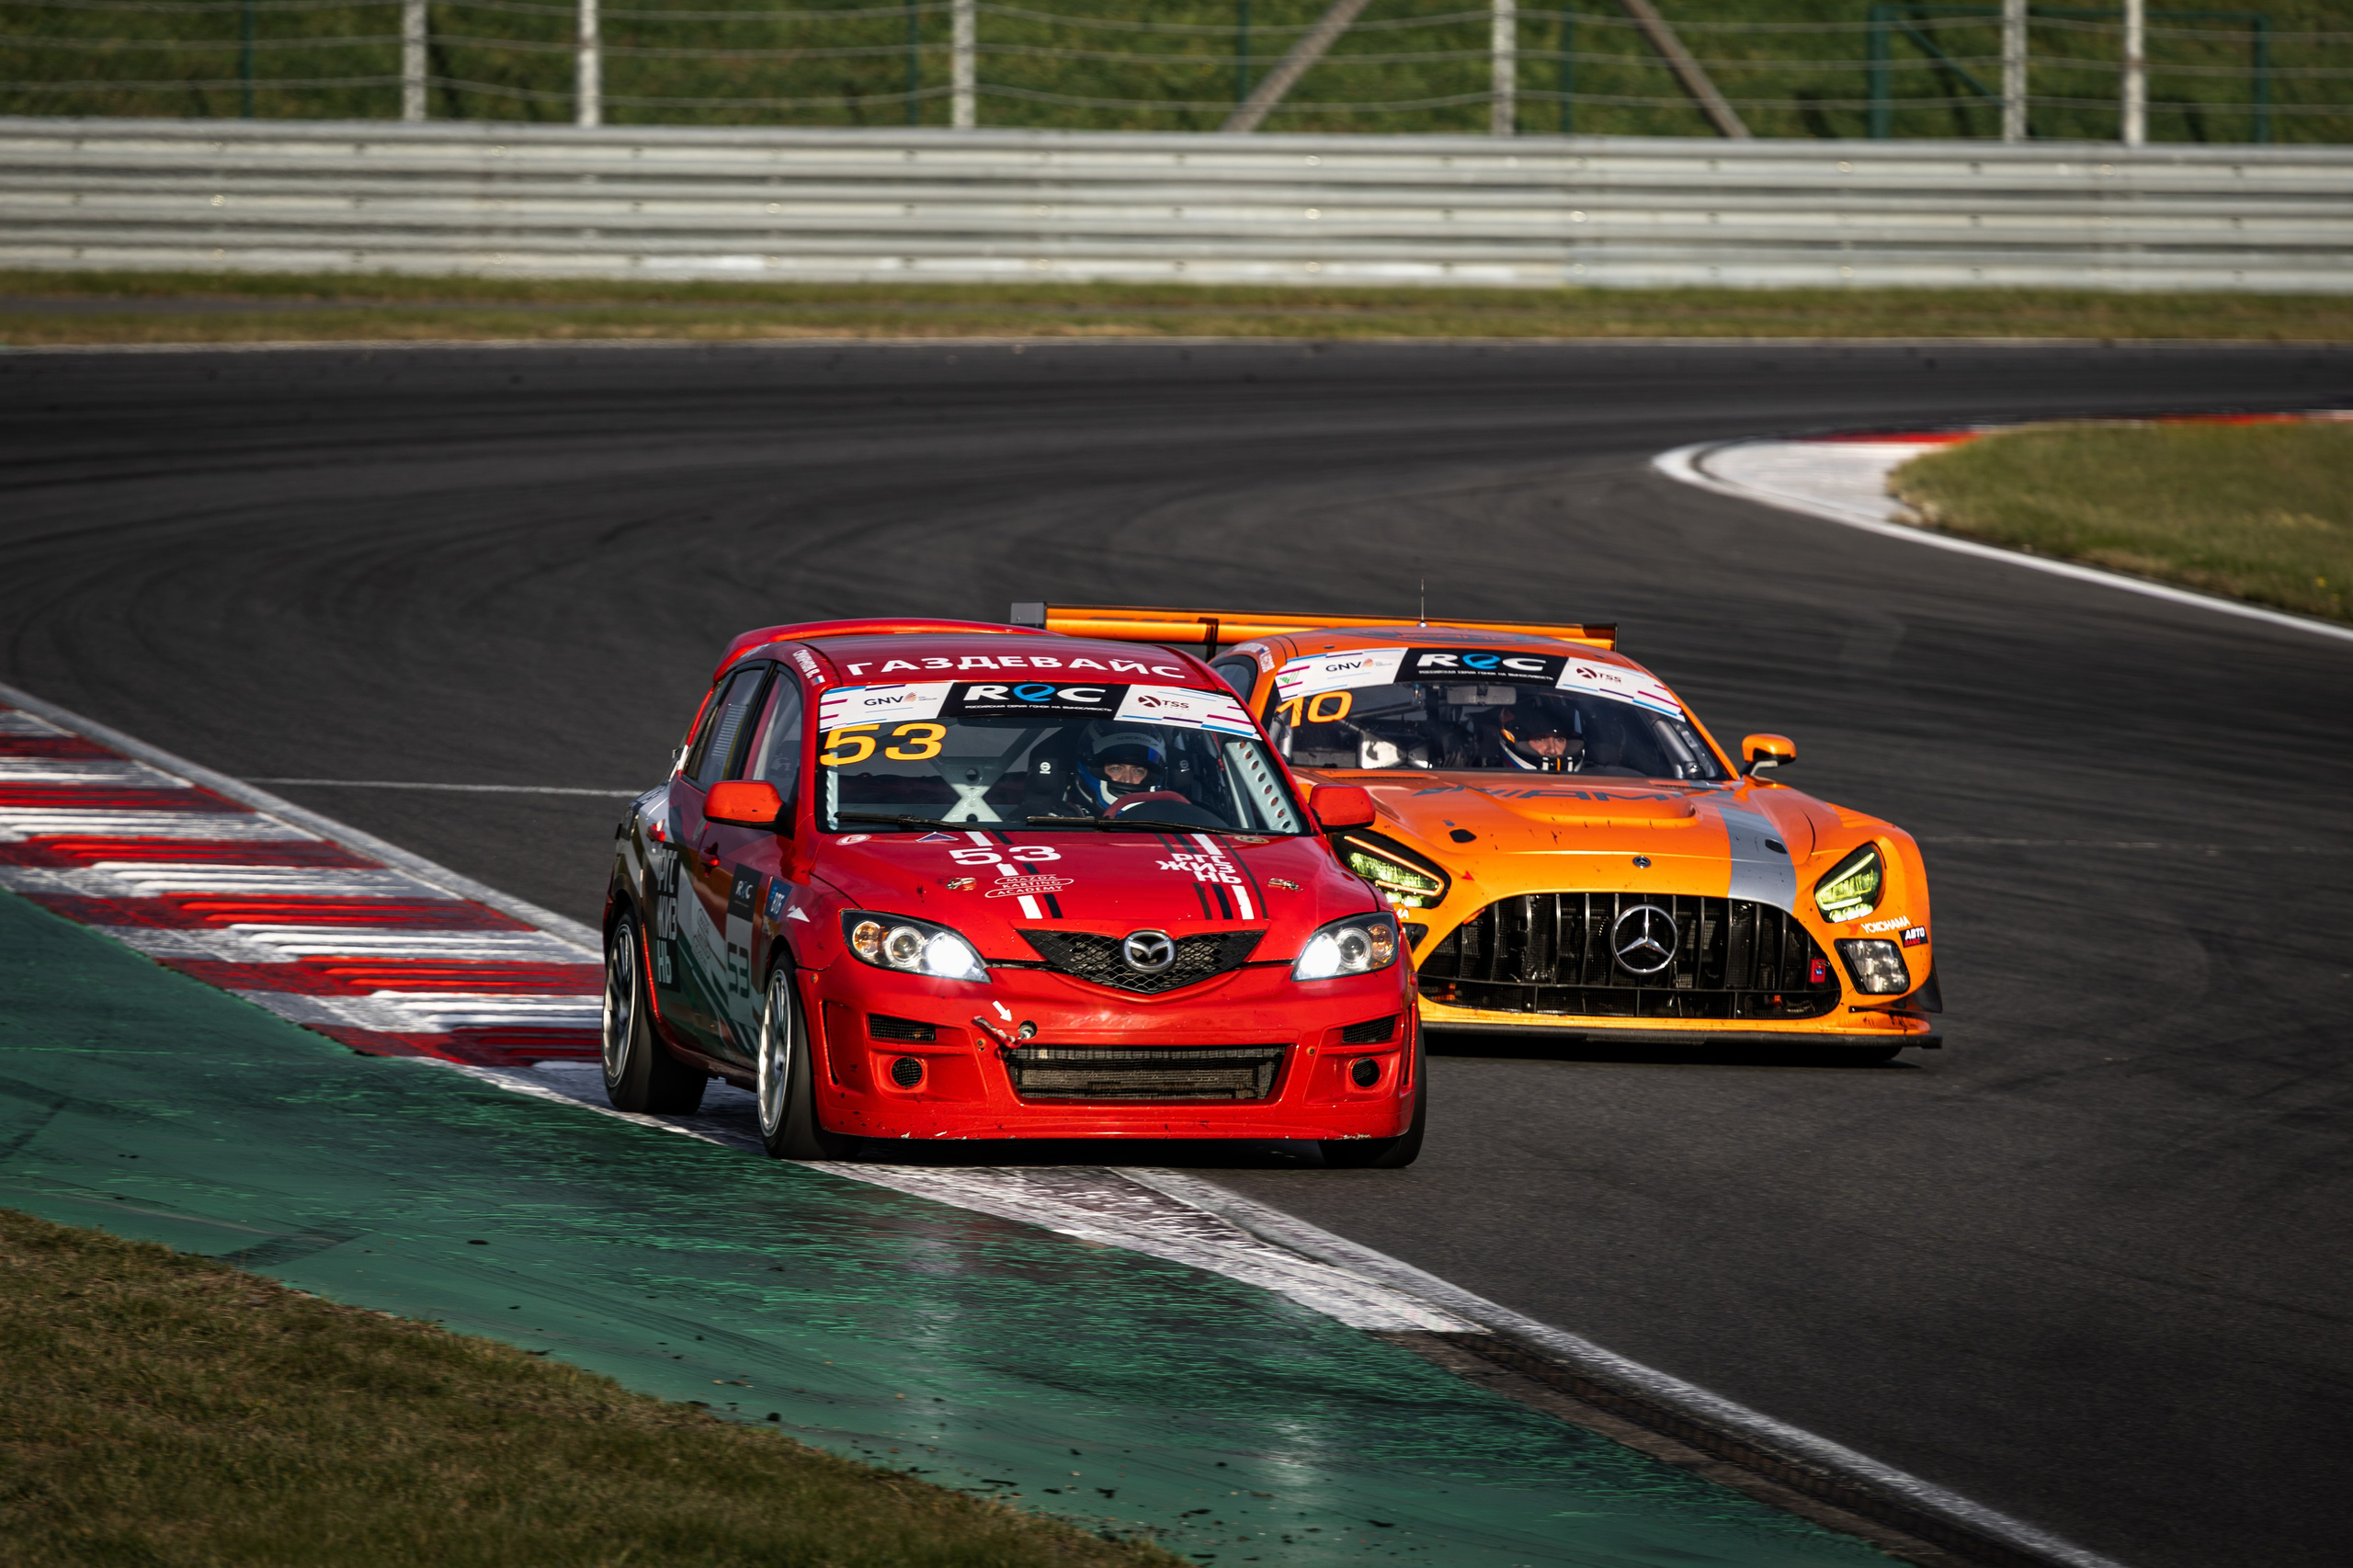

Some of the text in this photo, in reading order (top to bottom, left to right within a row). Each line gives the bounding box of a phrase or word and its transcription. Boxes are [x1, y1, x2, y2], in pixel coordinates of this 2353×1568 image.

[847, 655, 1186, 679] ГАЗДЕВАЙС
[1325, 661, 1362, 672] GNV
[864, 696, 904, 706] GNV
[1162, 699, 1189, 709] TSS
[1276, 690, 1353, 728] 10
[819, 722, 948, 767] 53
[949, 846, 1062, 865] 53
[1171, 853, 1232, 865] РГС
[1155, 860, 1237, 874] ЖИЗ
[1193, 870, 1243, 884] НЬ
[997, 885, 1063, 896] ACADEMY
[1002, 881, 1062, 889] KARTING
[1860, 915, 1911, 935] YOKOHAMA
[1904, 926, 1926, 941] АВТО
[728, 941, 750, 999] 53
